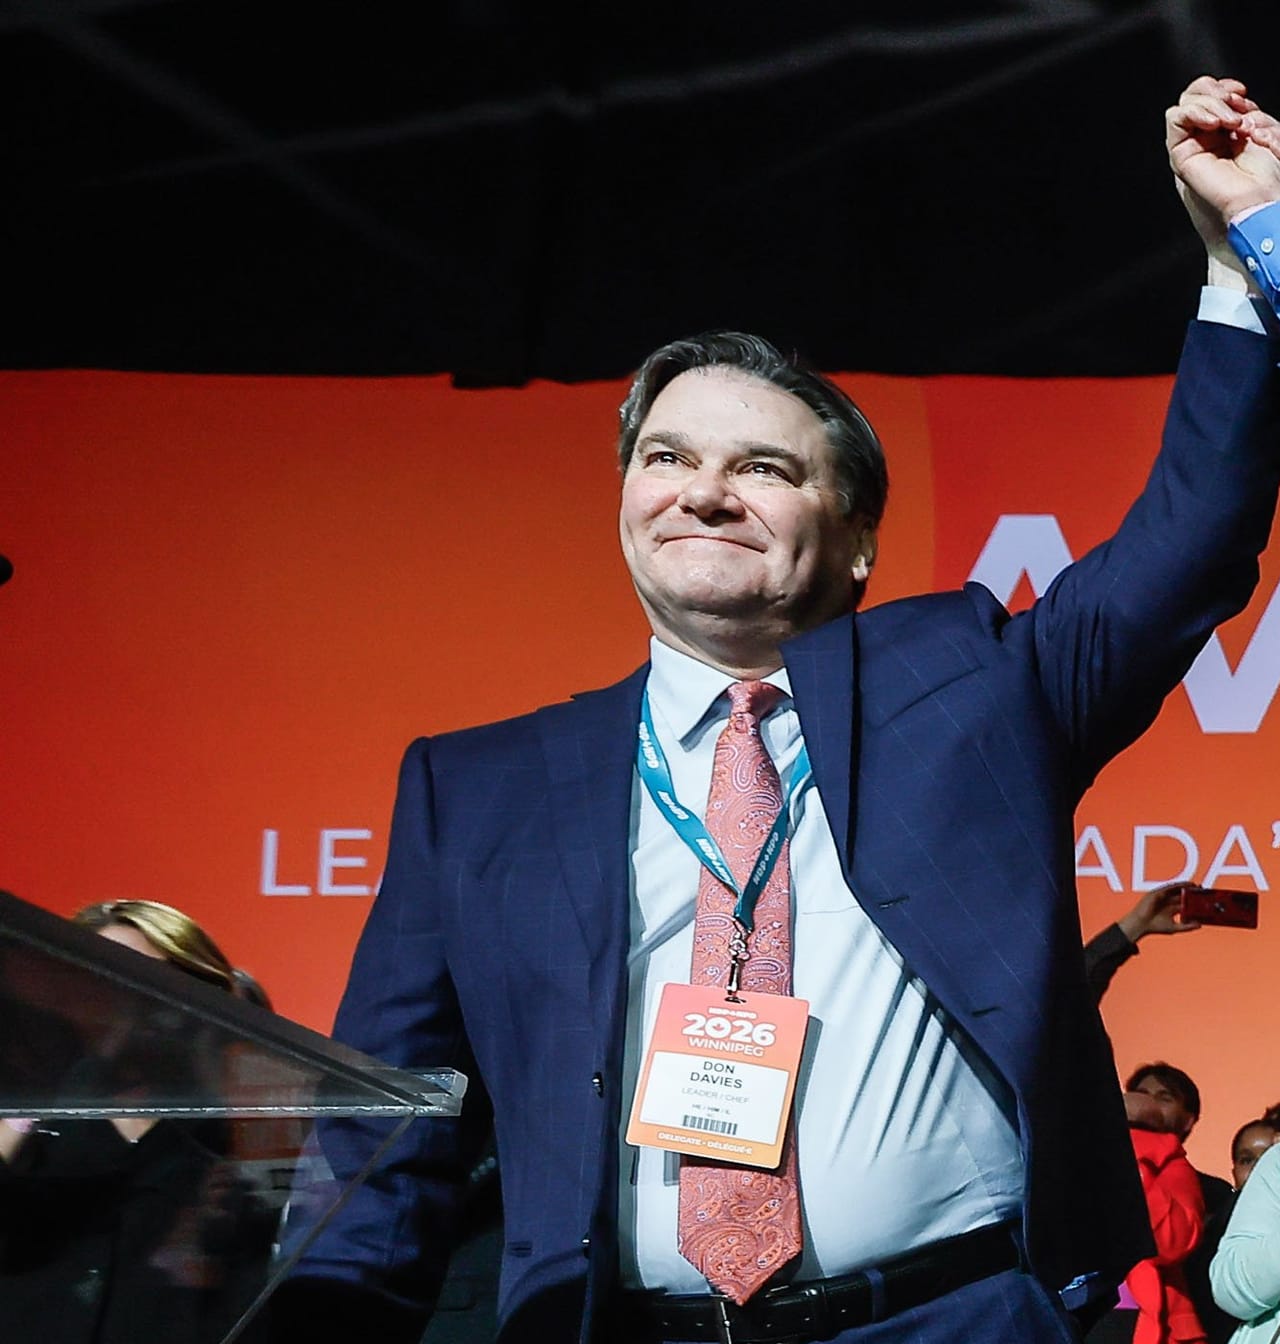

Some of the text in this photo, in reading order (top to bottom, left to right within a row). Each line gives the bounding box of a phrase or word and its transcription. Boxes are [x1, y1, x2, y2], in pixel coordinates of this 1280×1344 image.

[261, 828, 384, 896] LE
[682, 1014, 776, 1046] 2026
[688, 1037, 764, 1057] WINNIPEG
[703, 1061, 735, 1074] DON
[690, 1072, 742, 1089] DAVIES
[682, 1087, 718, 1099] LEADER
